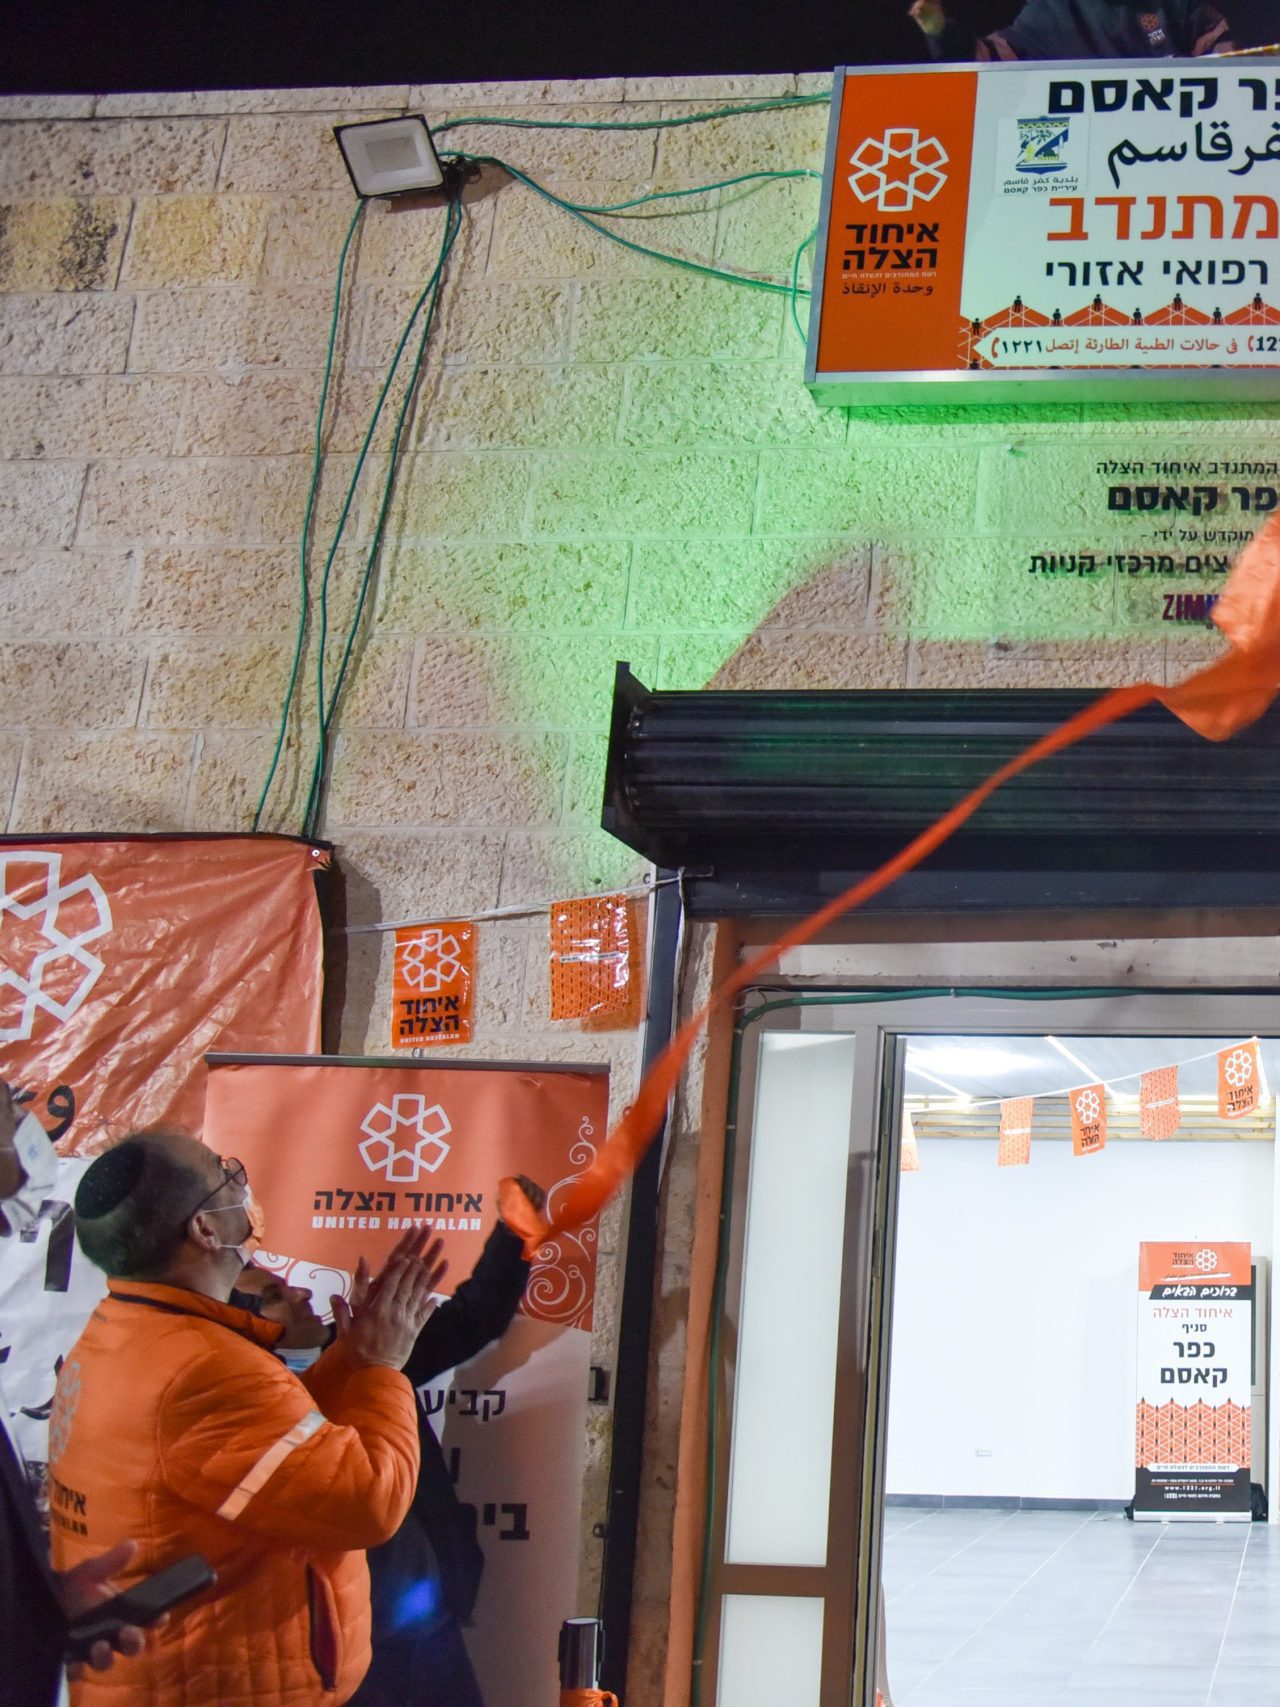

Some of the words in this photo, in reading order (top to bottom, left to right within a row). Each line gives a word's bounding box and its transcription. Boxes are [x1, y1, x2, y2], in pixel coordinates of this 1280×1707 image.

[1047, 77, 1219, 118] קאסם
[1003, 187, 1029, 195] קאסם
[846, 222, 940, 244] איחוד
[843, 247, 938, 270] הצלה
[1044, 260, 1145, 287] אזורי
[1162, 259, 1268, 286] רפואי
[893, 281, 934, 296] وحدة
[1001, 340, 1043, 354] ١٢٢١
[1085, 338, 1129, 353] الطارئة
[1134, 337, 1175, 355] الطبية
[1179, 337, 1221, 352] حالات
[1096, 460, 1145, 475] הצלה
[1152, 462, 1202, 475] איחוד
[1208, 462, 1279, 475] המתנדב
[1107, 486, 1219, 516] קאסם
[1153, 530, 1173, 542] ידי
[1178, 528, 1198, 541] על
[1203, 530, 1254, 543] מוקדש
[1028, 554, 1096, 577] קניות
[1107, 555, 1175, 574] מרכזי
[1184, 555, 1228, 574] צים
[400, 996, 460, 1015] איחוד
[400, 1015, 460, 1035] הצלה
[313, 1188, 396, 1212] הצלה
[404, 1193, 483, 1212] איחוד
[311, 1216, 381, 1229] UNITED
[1162, 1284, 1197, 1298] הבאים
[1199, 1286, 1238, 1299] ברוכים
[1153, 1306, 1190, 1319] הצלה
[1194, 1308, 1233, 1319] איחוד
[1182, 1324, 1208, 1334] סניף
[1173, 1342, 1215, 1358] כפר
[1160, 1368, 1228, 1388] קאסם
